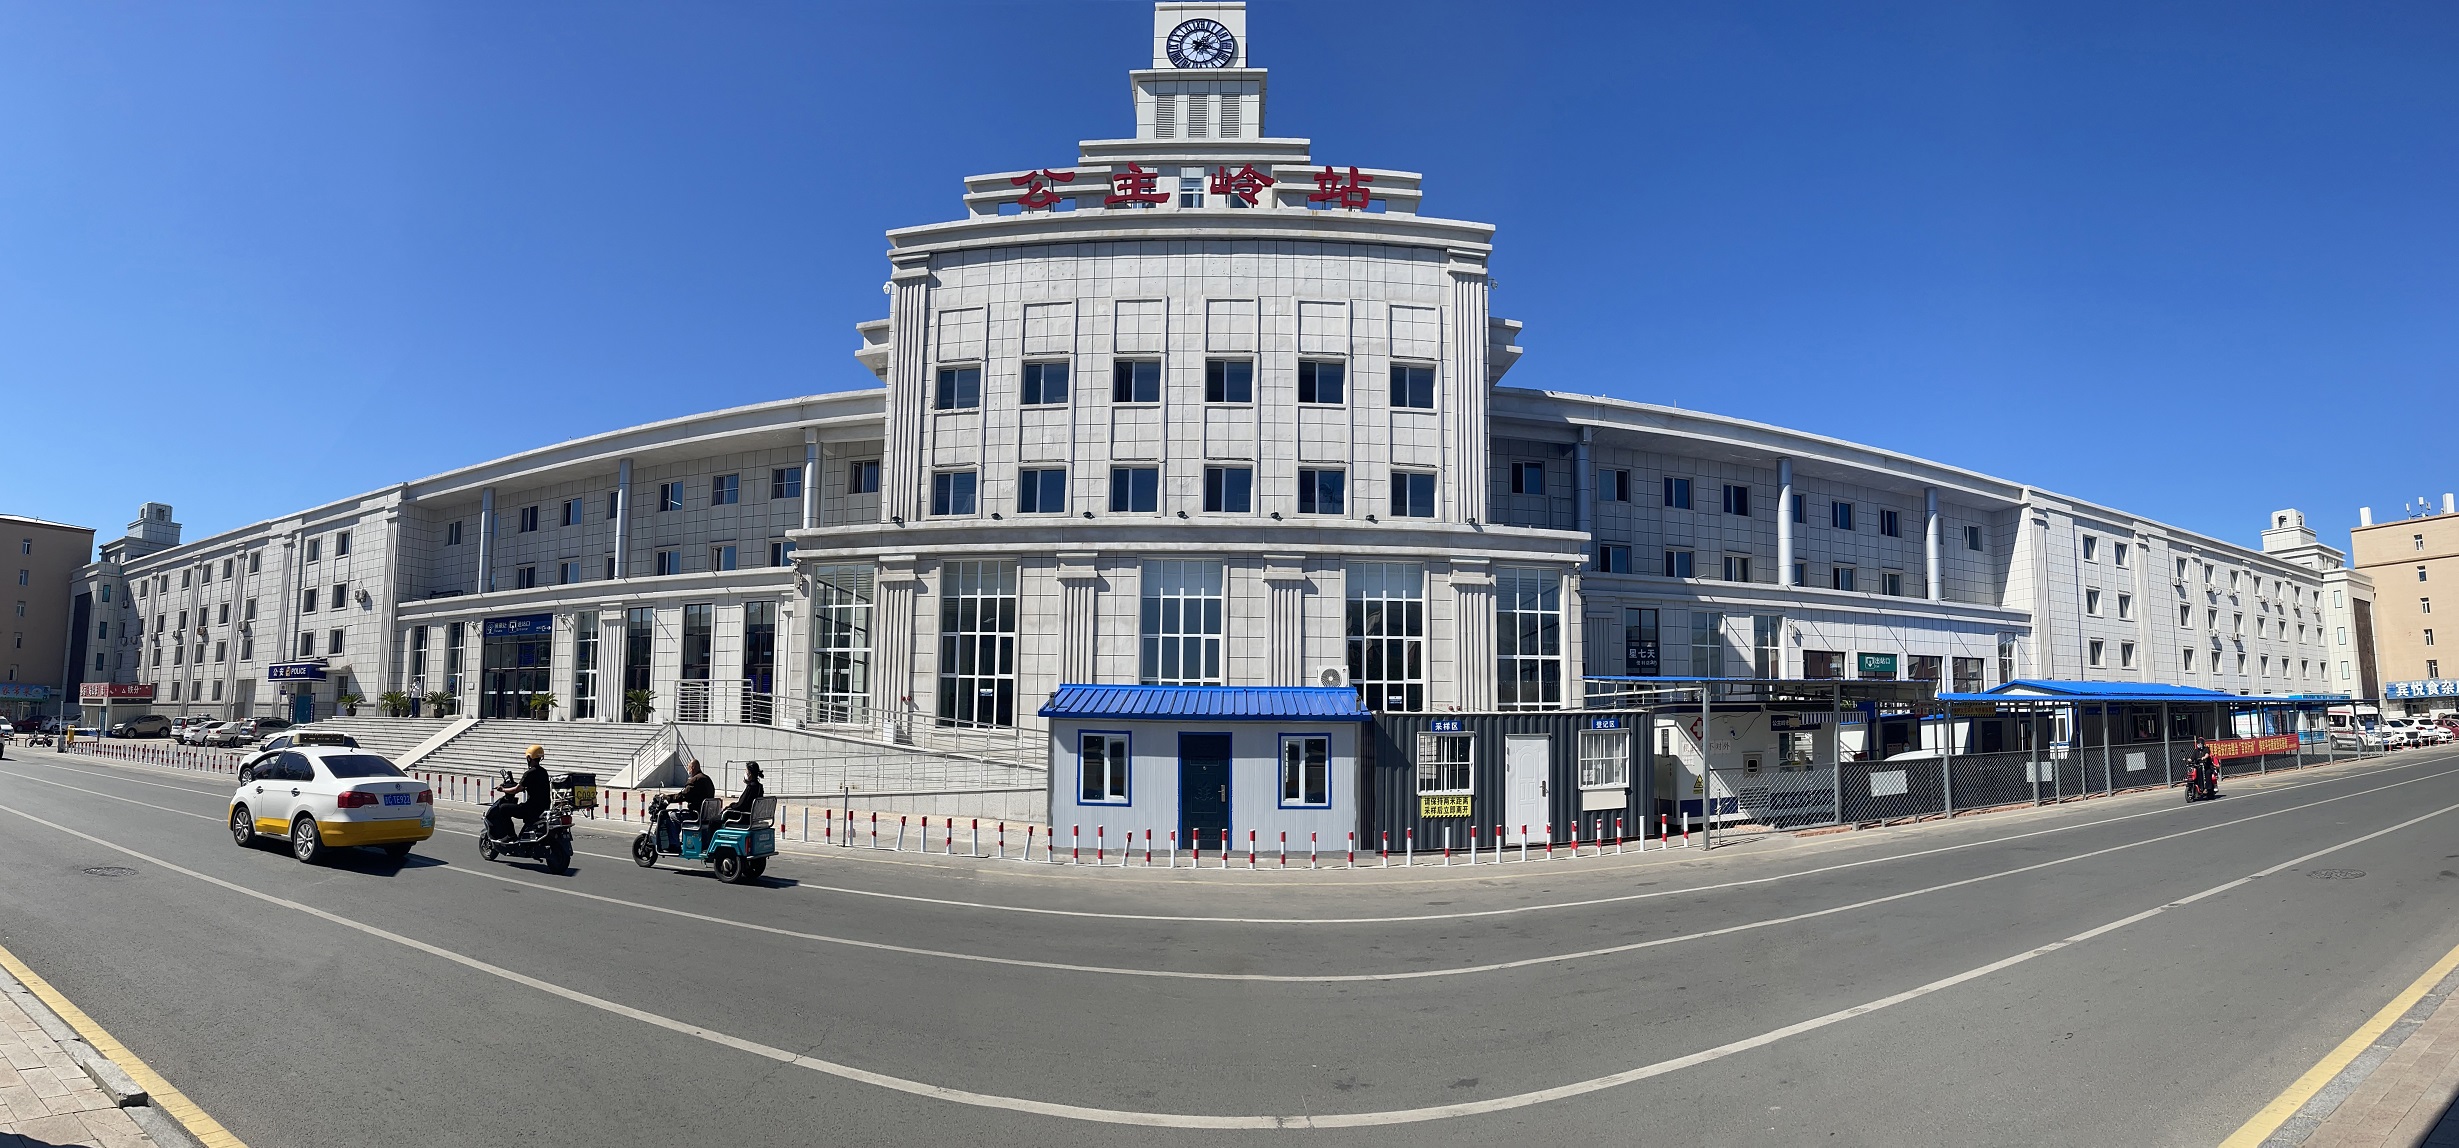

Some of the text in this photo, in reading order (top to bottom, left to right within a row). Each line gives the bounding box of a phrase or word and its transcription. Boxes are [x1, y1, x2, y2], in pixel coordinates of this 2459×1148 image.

[1010, 162, 1374, 209] 公主岭站
[1628, 648, 1655, 659] 星七天
[273, 667, 307, 677] 公安 POLICE
[2395, 680, 2459, 697] 宾悦食杂
[1435, 722, 1459, 731] 采样区
[1596, 720, 1615, 728] 登记区
[1424, 797, 1469, 806] 请保持两米距离
[1424, 806, 1469, 815] 采样后立即离开
